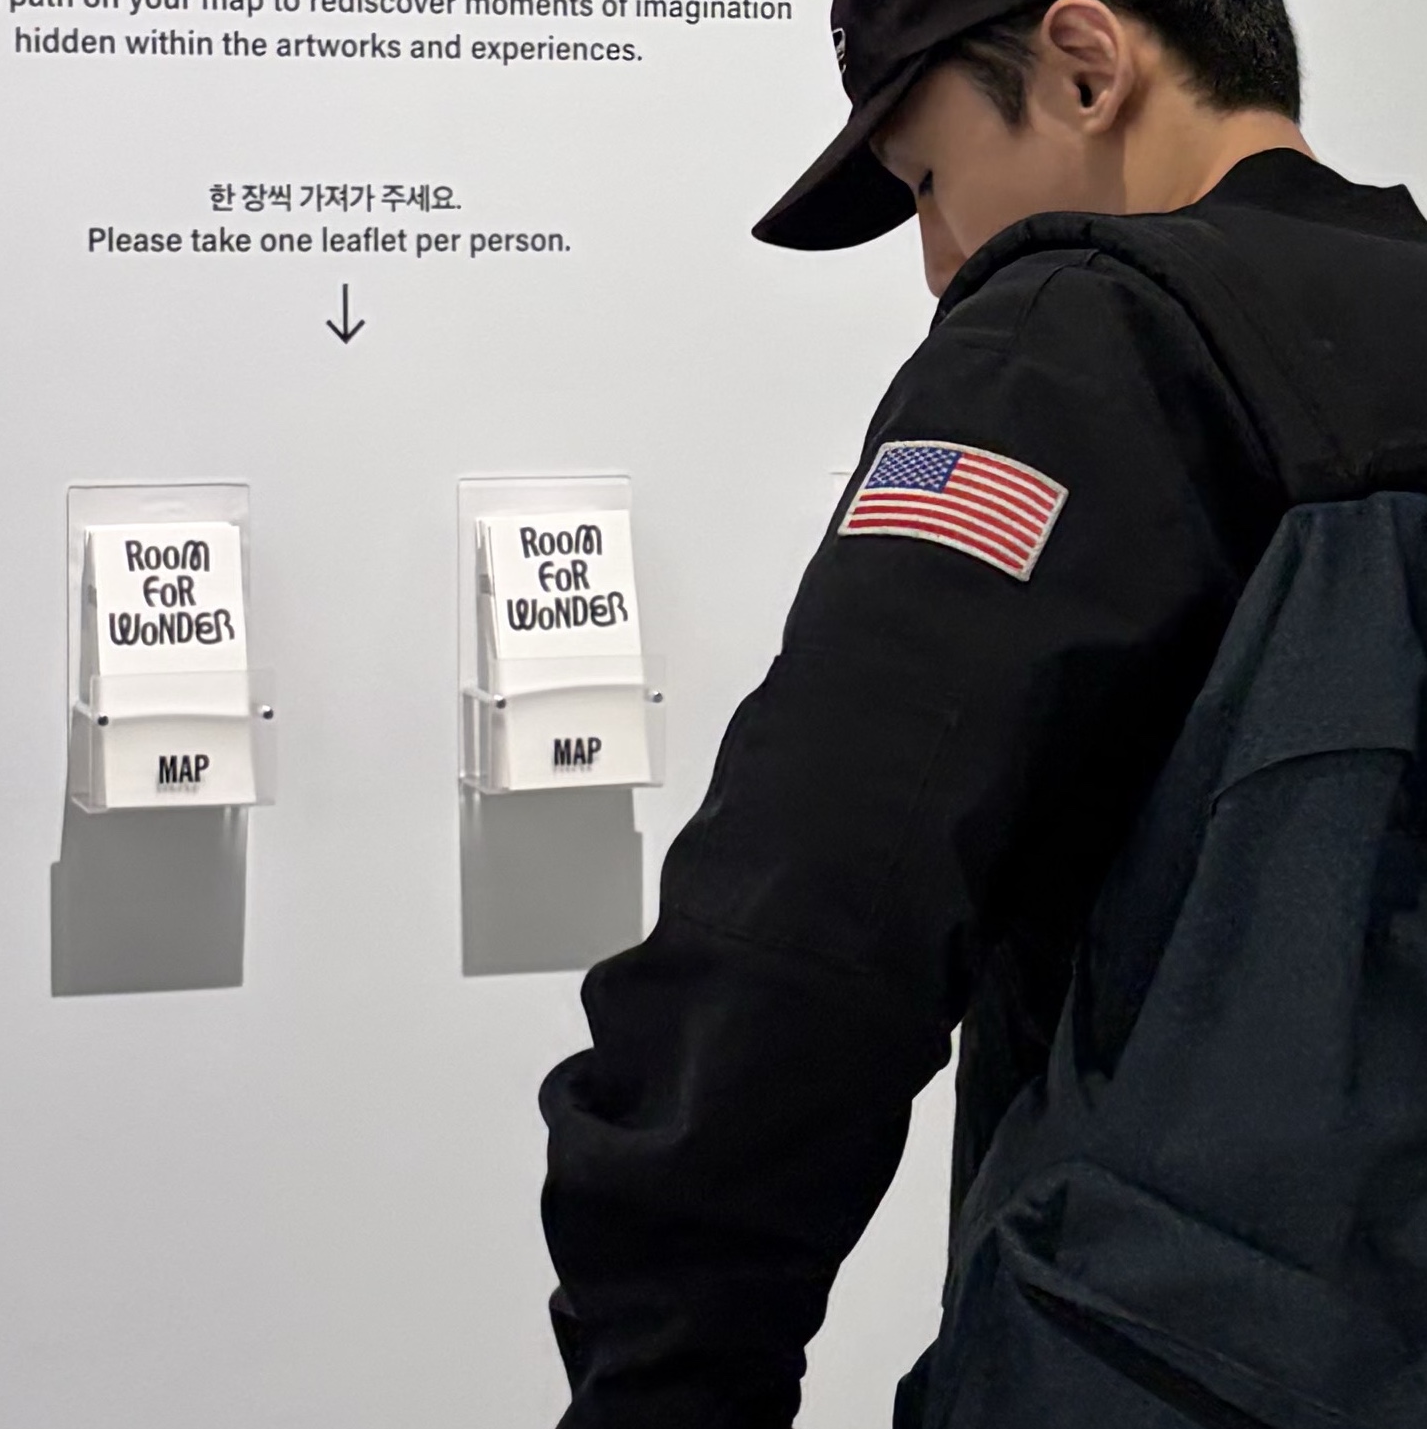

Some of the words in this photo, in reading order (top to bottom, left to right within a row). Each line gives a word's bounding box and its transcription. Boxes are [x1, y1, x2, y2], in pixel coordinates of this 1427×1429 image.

[15, 26, 116, 54] hidden
[124, 28, 213, 56] within
[221, 30, 268, 57] the
[276, 32, 402, 59] artworks
[410, 33, 461, 60] and
[471, 34, 643, 67] experiences.
[209, 183, 237, 212] 한
[241, 183, 292, 213] 장씩
[299, 183, 376, 213] 가져가
[381, 184, 462, 213] 주세요.
[88, 226, 183, 253] Please
[190, 226, 252, 253] take
[260, 233, 313, 253] one
[322, 226, 408, 253] leaflet
[416, 233, 462, 259] per
[470, 232, 571, 259] person.
[553, 736, 602, 767] MAP
[158, 754, 210, 785] MAP
